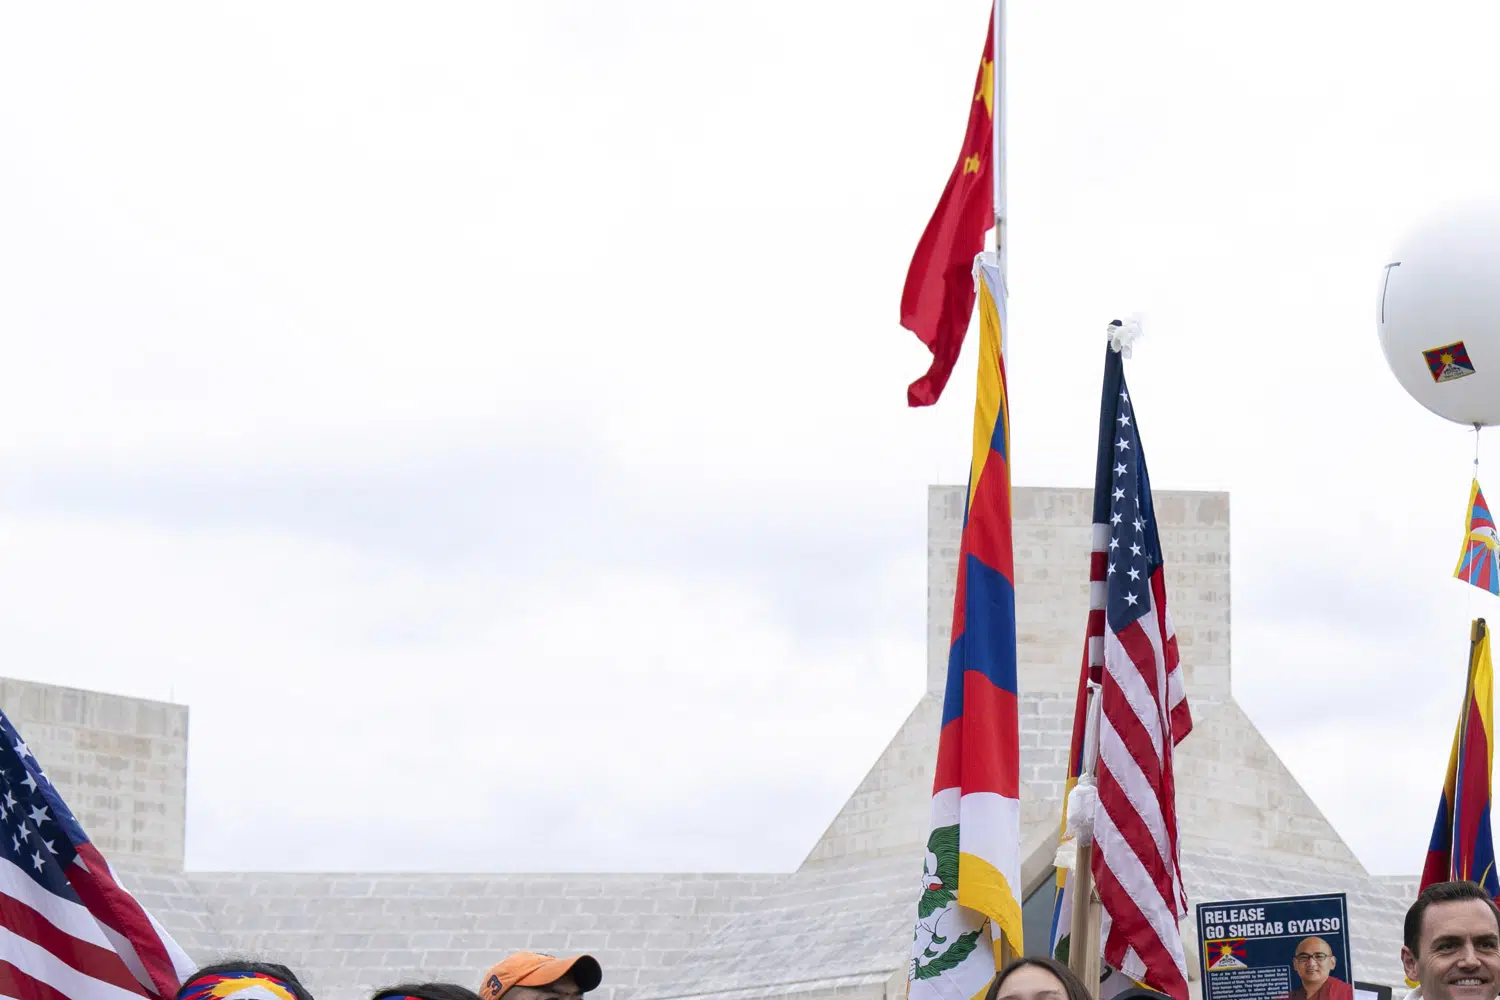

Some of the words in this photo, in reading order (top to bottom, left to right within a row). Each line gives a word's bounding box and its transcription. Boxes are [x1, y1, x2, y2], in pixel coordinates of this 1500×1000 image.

[1204, 907, 1265, 924] RELEASE
[1206, 925, 1225, 939] GO
[1228, 921, 1284, 938] SHERAB
[1288, 917, 1341, 933] GYATSO
